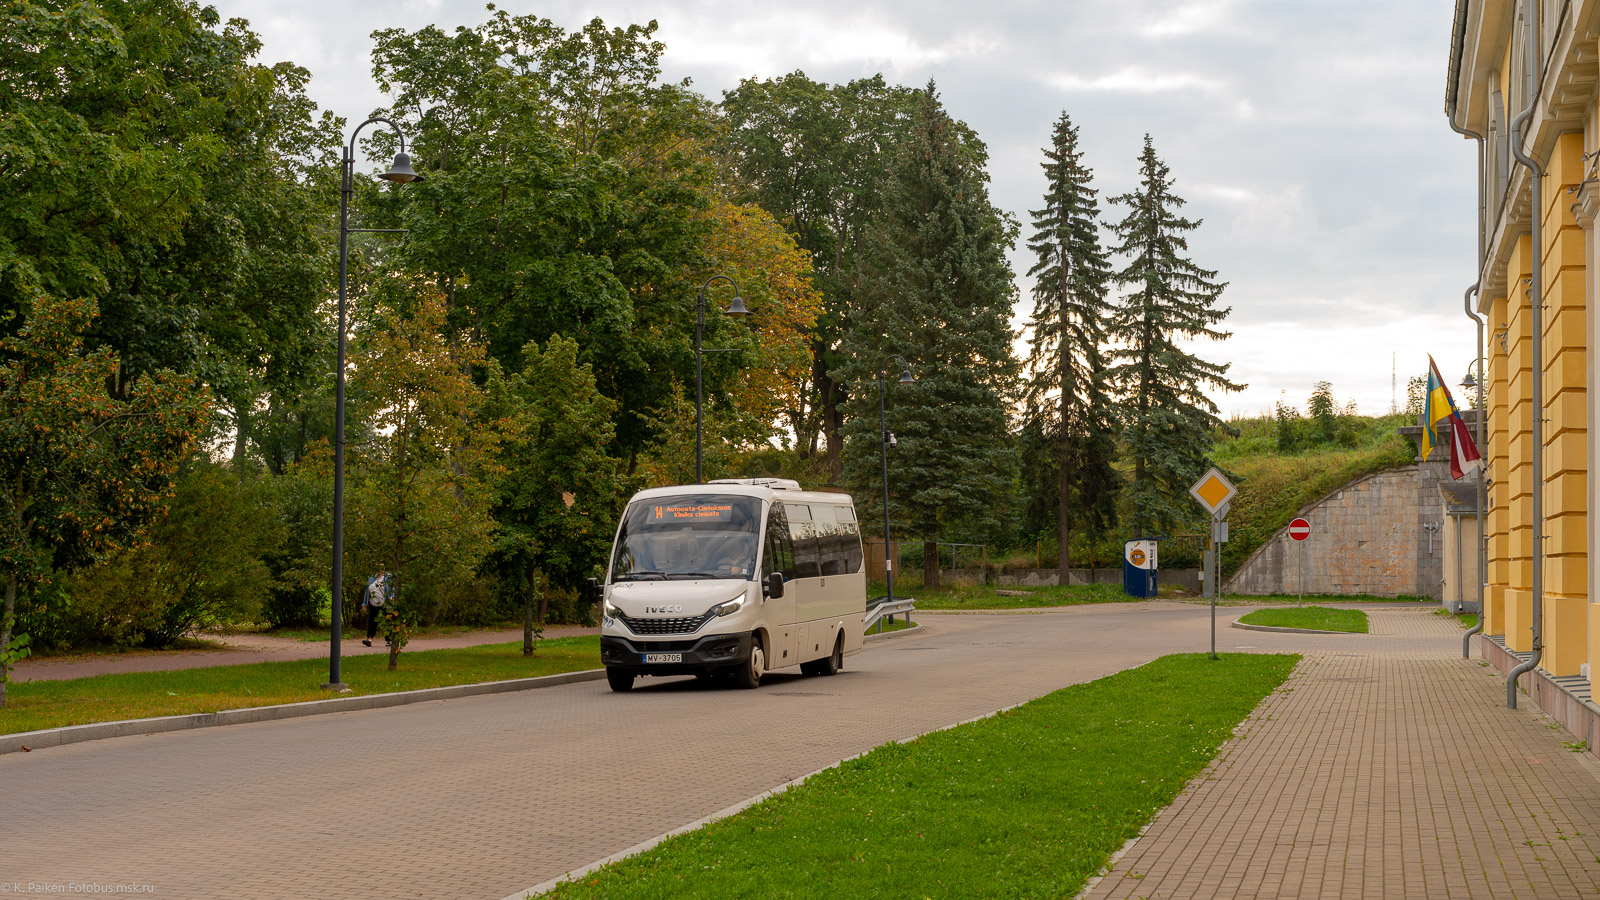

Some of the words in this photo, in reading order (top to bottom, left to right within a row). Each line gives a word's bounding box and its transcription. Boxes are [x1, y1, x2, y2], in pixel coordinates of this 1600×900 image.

[655, 506, 663, 519] 14
[646, 605, 682, 613] IVECO
[647, 654, 681, 662] MV-3705
